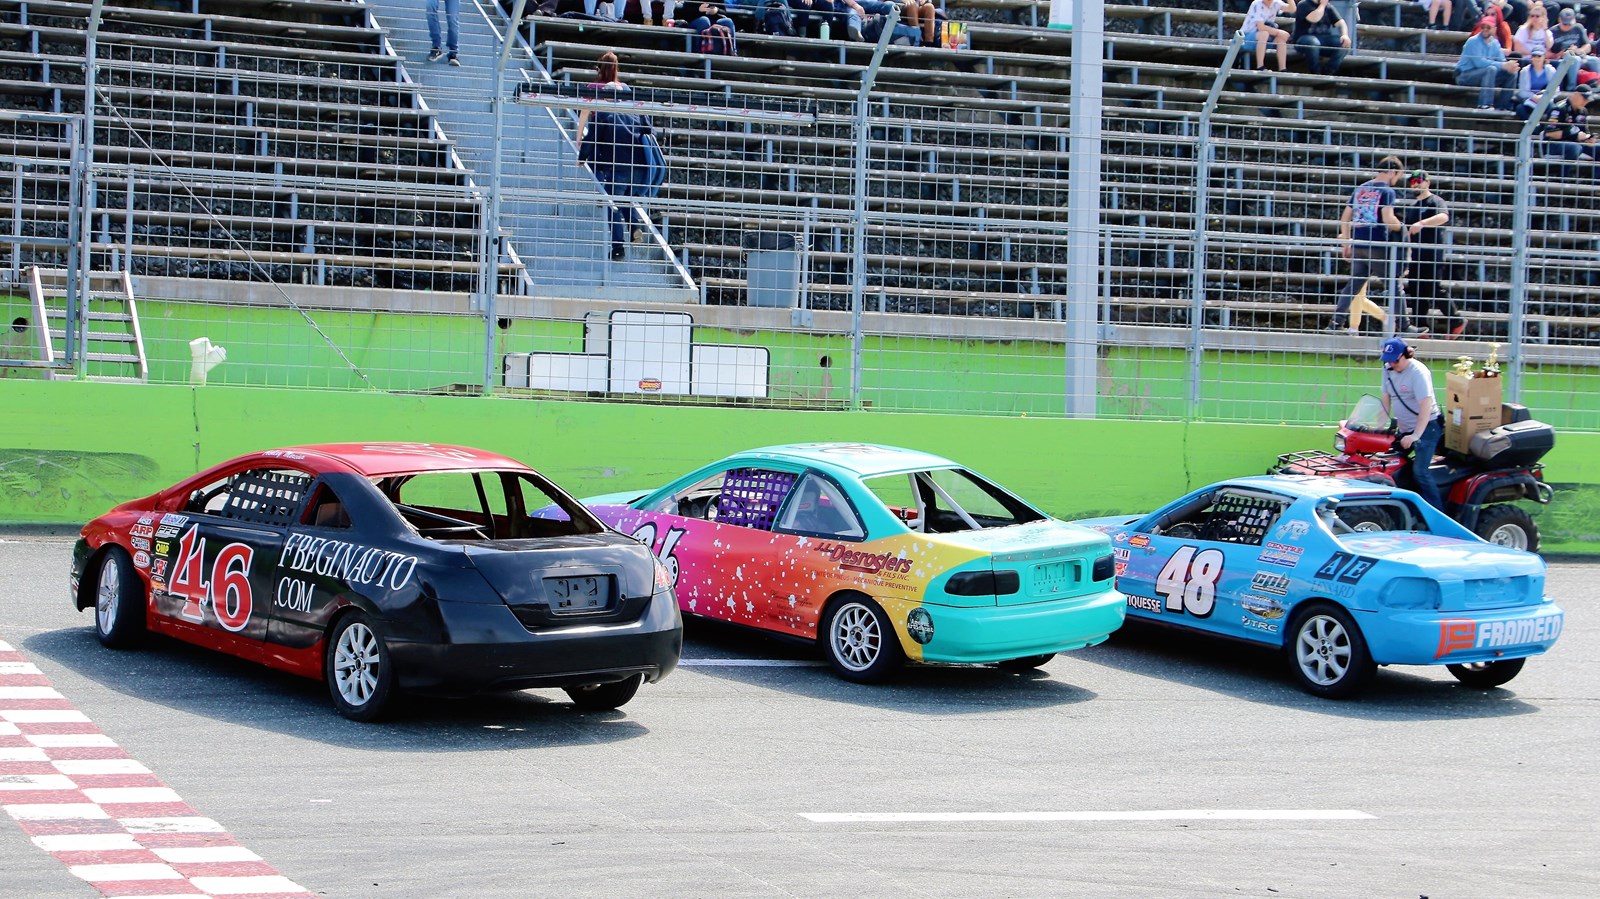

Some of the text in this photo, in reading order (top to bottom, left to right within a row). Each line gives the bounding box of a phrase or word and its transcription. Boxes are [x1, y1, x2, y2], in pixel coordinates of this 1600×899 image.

[130, 525, 153, 536] ARP
[157, 525, 180, 534] PFC
[156, 544, 170, 554] OMP
[1265, 541, 1304, 554] CENTRE
[135, 553, 148, 564] BELL
[278, 532, 418, 590] FBEGINAUTO
[829, 544, 914, 574] Desrosiers
[168, 523, 254, 631] 46
[882, 571, 896, 579] FILS
[1156, 545, 1225, 618] 48
[274, 576, 316, 613] .COM
[1476, 615, 1561, 648] FRAMECO
